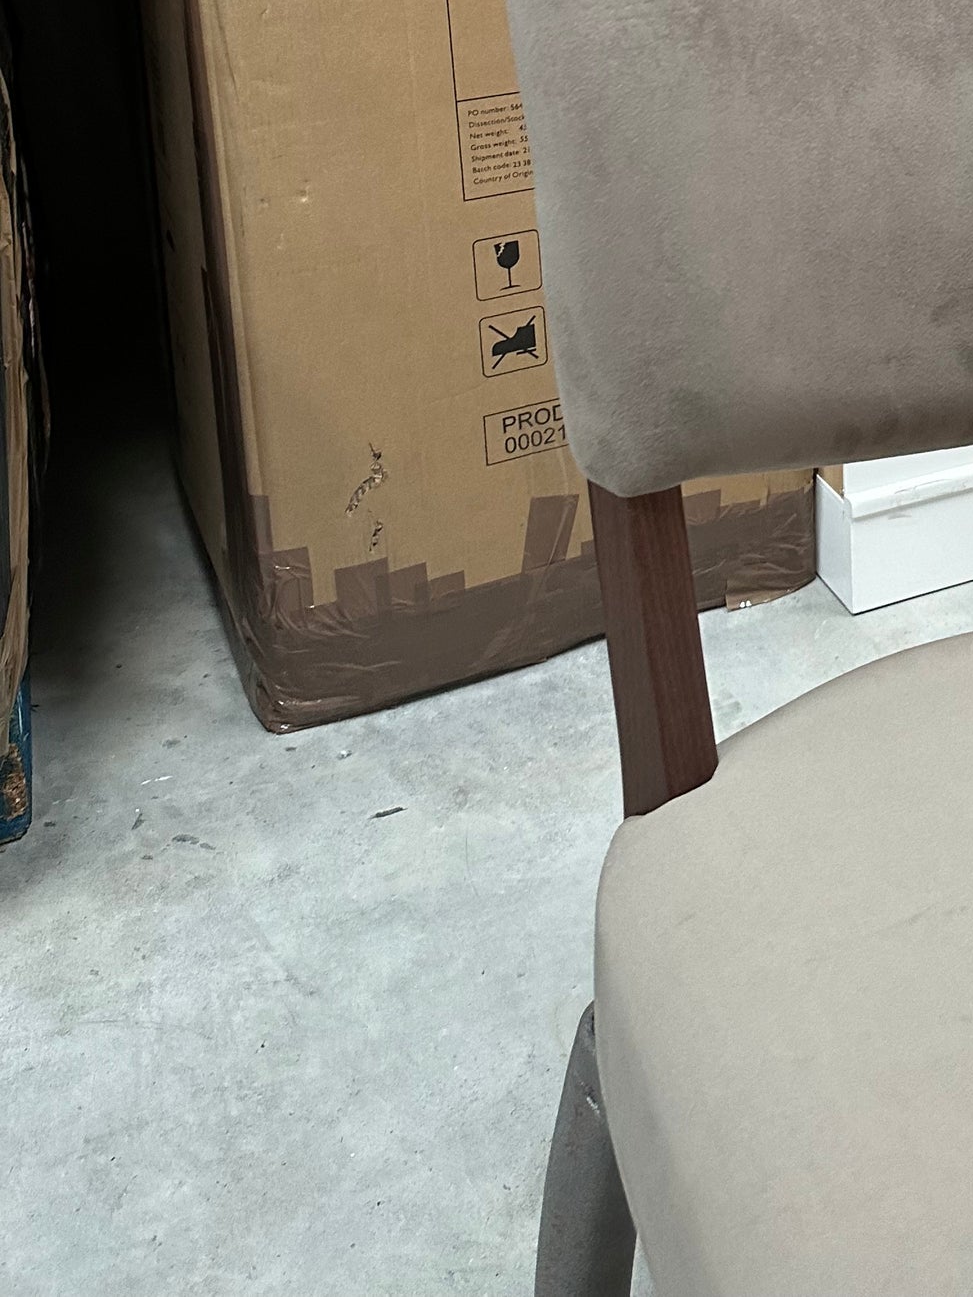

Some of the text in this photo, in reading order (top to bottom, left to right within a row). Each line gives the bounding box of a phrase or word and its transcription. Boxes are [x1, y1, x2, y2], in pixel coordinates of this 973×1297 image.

[467, 109, 479, 117] PO
[470, 132, 483, 140] Net
[470, 143, 491, 151] Gross
[471, 151, 503, 162] Shipment
[472, 166, 491, 174] Batch
[473, 174, 502, 185] Country
